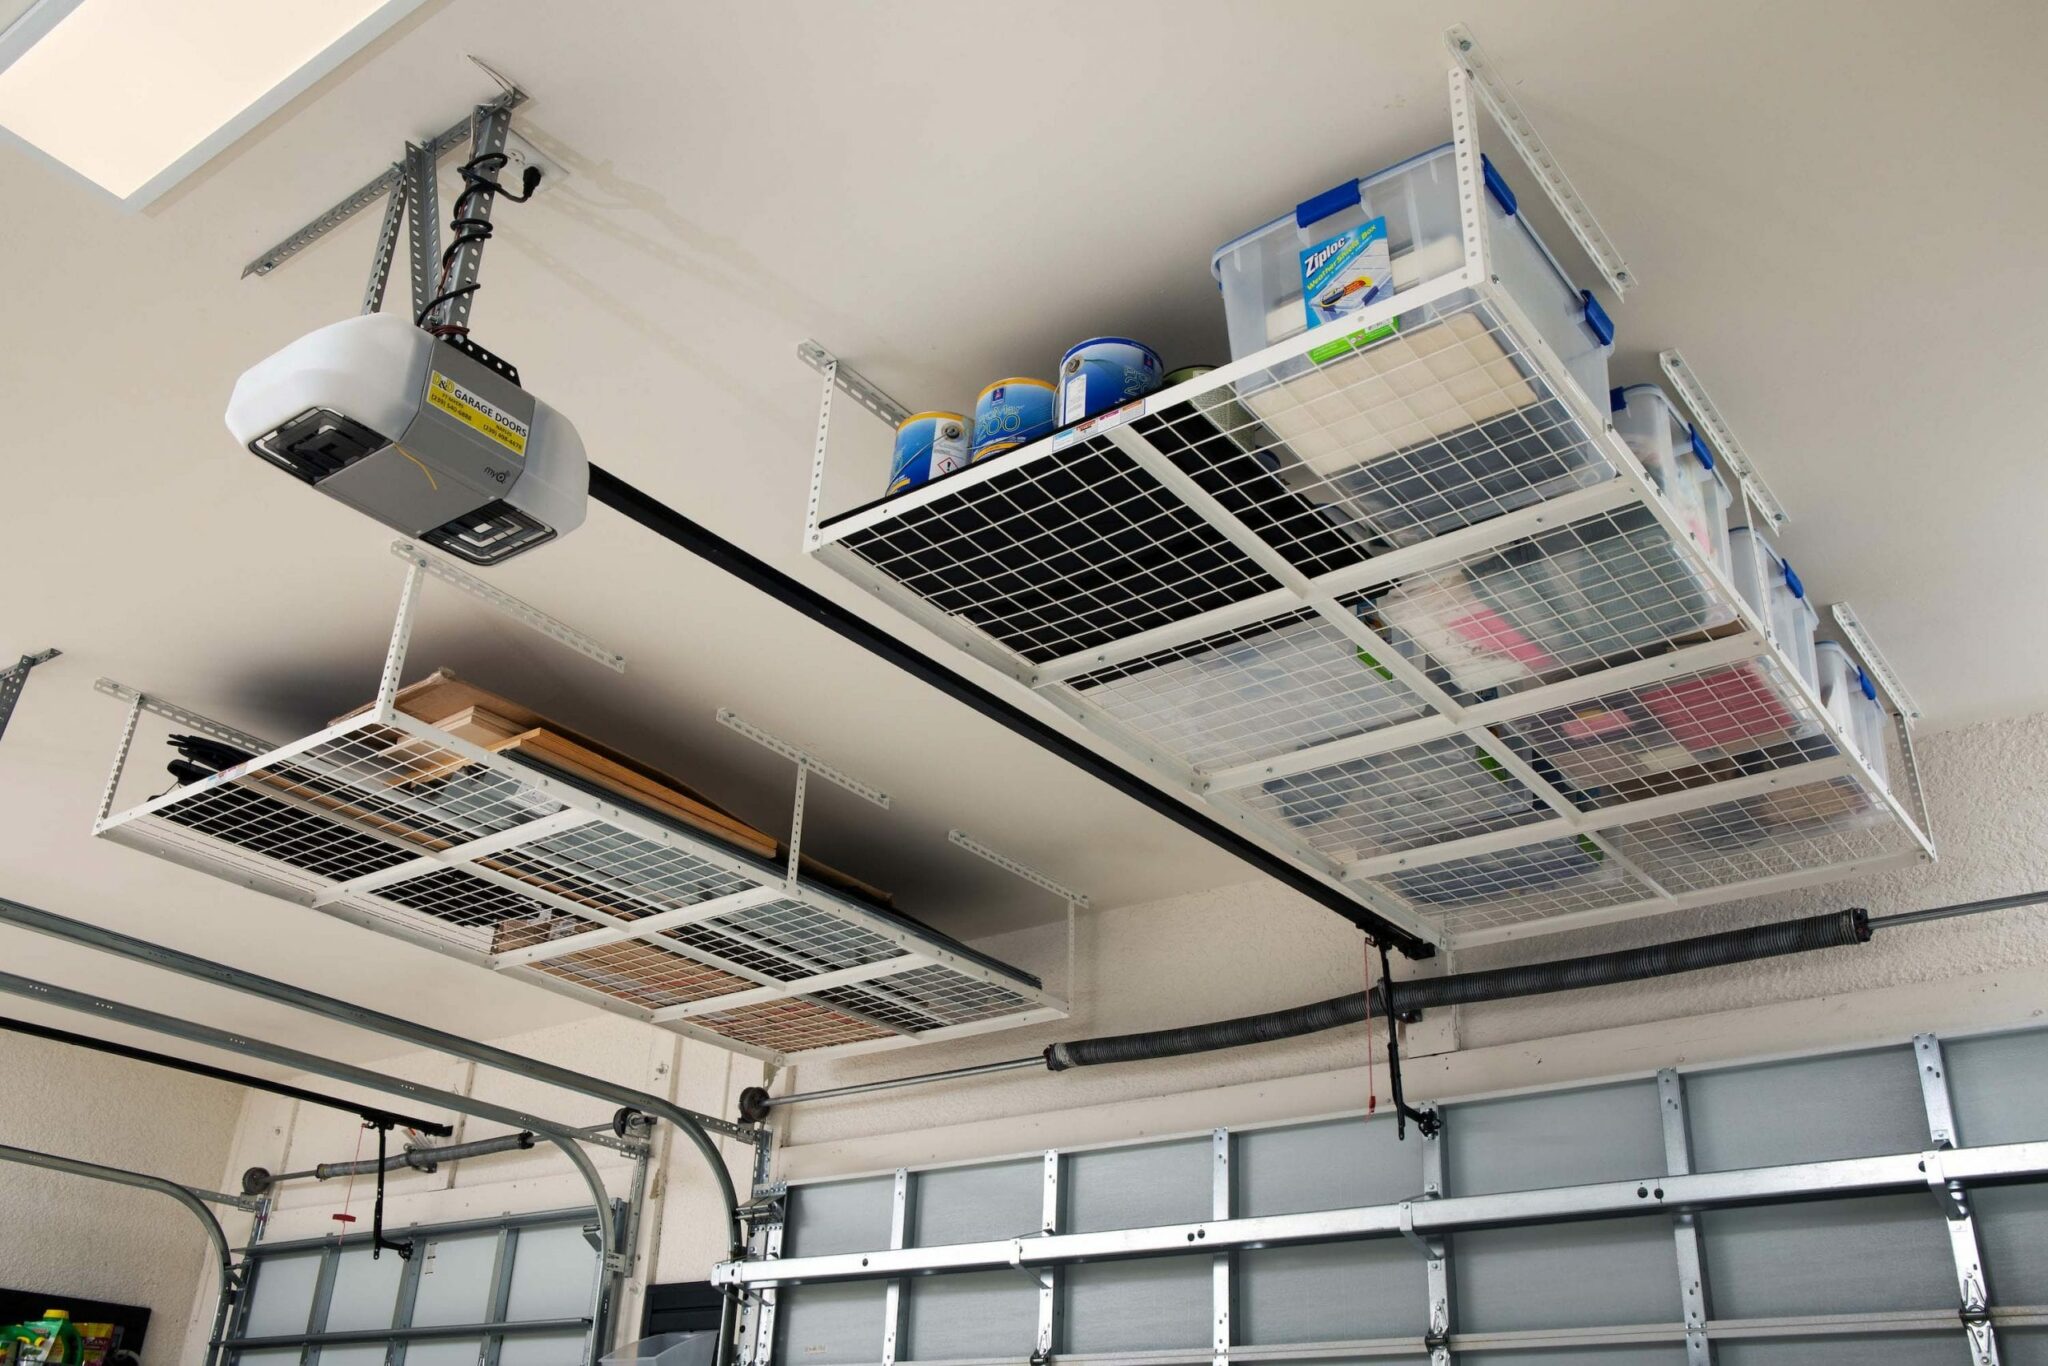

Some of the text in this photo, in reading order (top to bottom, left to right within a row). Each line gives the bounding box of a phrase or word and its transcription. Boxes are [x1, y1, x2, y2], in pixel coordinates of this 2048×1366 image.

[1304, 238, 1345, 278] Ziploc
[432, 371, 527, 438] D&D GARAGE DOORS
[484, 466, 506, 485] myQ
